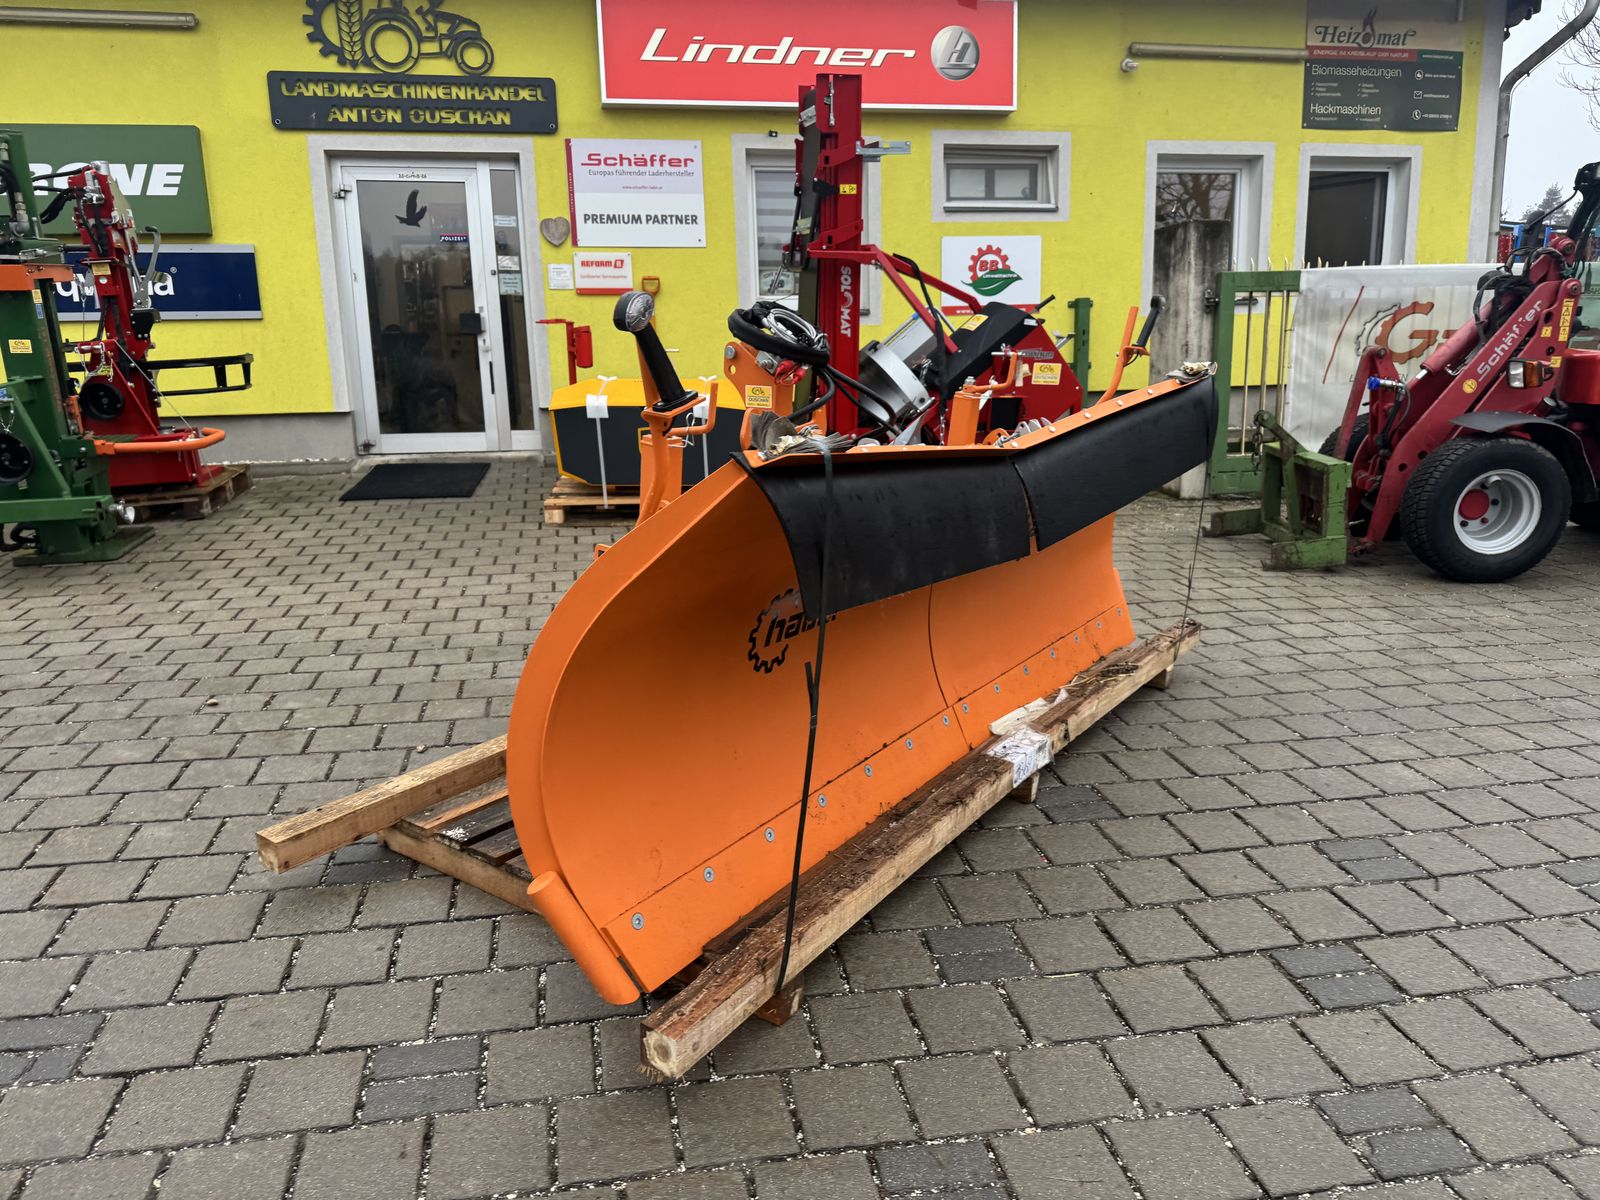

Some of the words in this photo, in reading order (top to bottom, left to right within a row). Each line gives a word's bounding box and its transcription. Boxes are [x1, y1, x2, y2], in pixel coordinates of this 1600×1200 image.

[1314, 25, 1417, 48] Heizomat
[640, 28, 916, 67] Lindner
[1311, 64, 1402, 79] Biomasseheizungen
[280, 78, 548, 102] LANDMASCHINENHANDEL
[328, 105, 402, 124] ANTON
[409, 107, 511, 126] OUSCHAN
[1310, 103, 1381, 115] Hackmaschinen
[581, 153, 694, 168] Schäffer
[588, 169, 614, 177] Europas
[615, 169, 647, 177] führender
[648, 169, 695, 177] Laderhersteller
[583, 213, 643, 225] PREMIUM
[645, 214, 699, 225] PARTNER
[978, 259, 999, 271] BB
